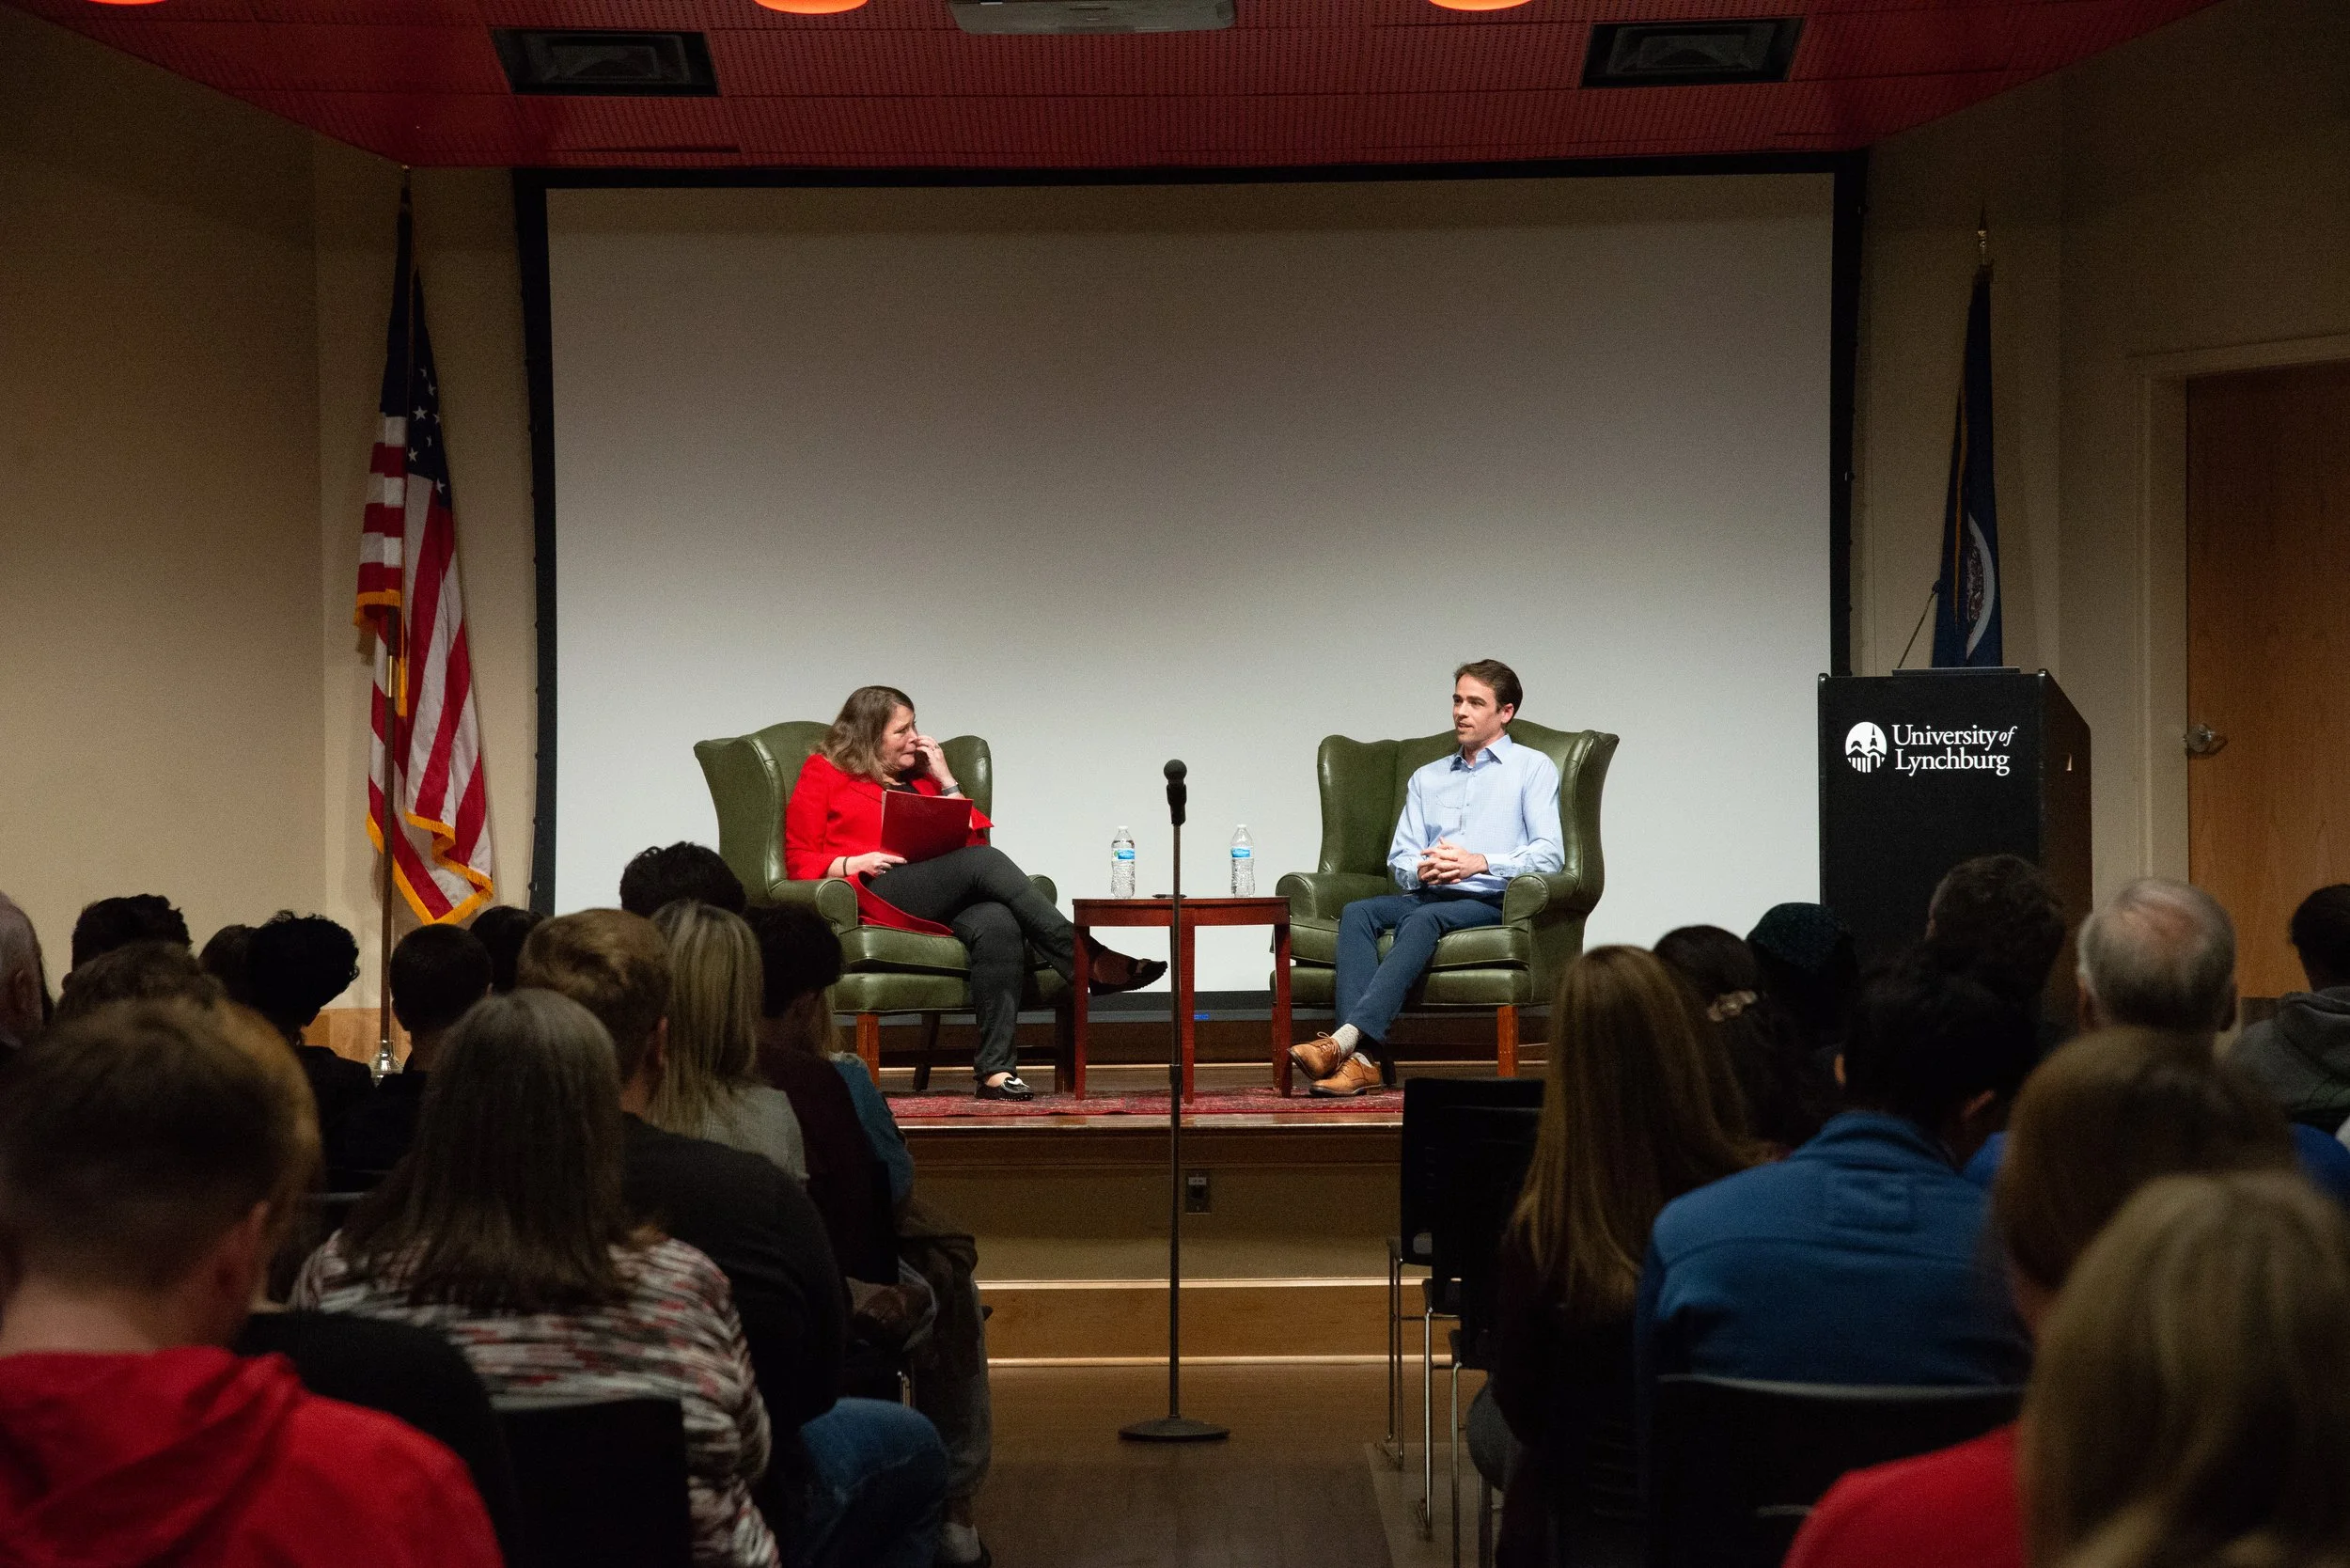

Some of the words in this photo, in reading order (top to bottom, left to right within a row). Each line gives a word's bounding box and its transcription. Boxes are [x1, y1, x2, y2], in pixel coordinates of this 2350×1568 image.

[1891, 724, 1998, 751] University
[1998, 725, 2018, 747] of
[1894, 746, 2011, 776] Lynchburg
